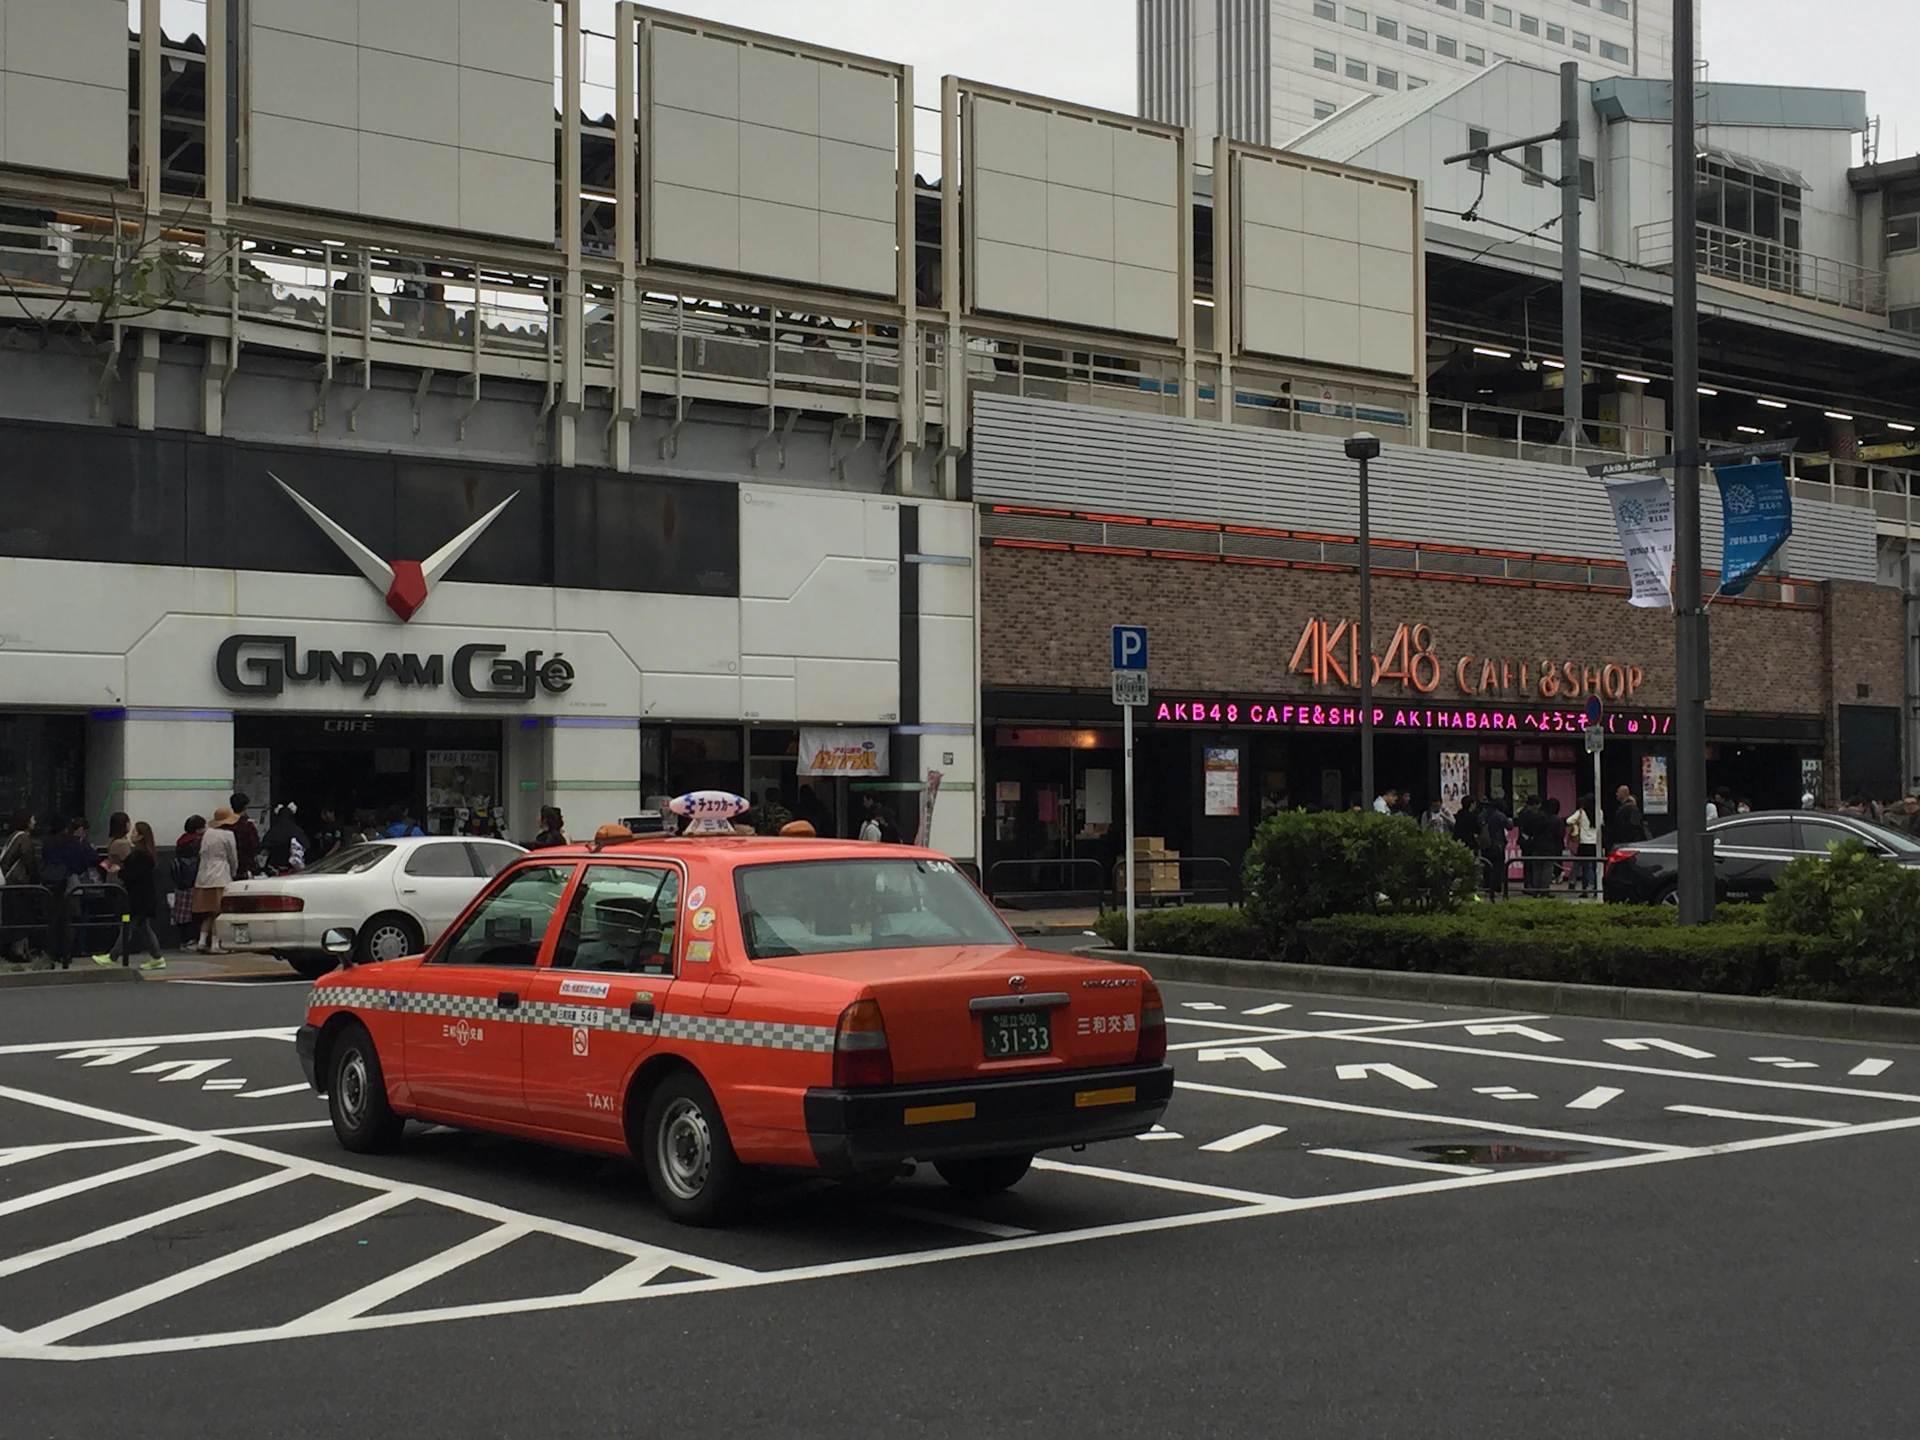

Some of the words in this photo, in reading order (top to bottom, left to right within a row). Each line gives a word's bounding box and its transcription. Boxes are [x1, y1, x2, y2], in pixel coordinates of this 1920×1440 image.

[1602, 462, 1628, 474] Akiba
[1630, 459, 1657, 471] Smile!
[1121, 630, 1142, 666] P
[1288, 617, 1440, 693] AKB48
[216, 634, 444, 697] GUNDAM
[452, 643, 575, 700] Café
[323, 719, 375, 733] CAFE
[1157, 702, 1239, 723] AKB48
[1250, 705, 1385, 726] CAFE&SHP
[1394, 709, 1518, 730] AKIHABARA
[698, 796, 734, 812] チェッカー
[580, 1010, 598, 1023] 549
[1077, 1013, 1136, 1035] 三和交通
[586, 1092, 614, 1112] TAXI
